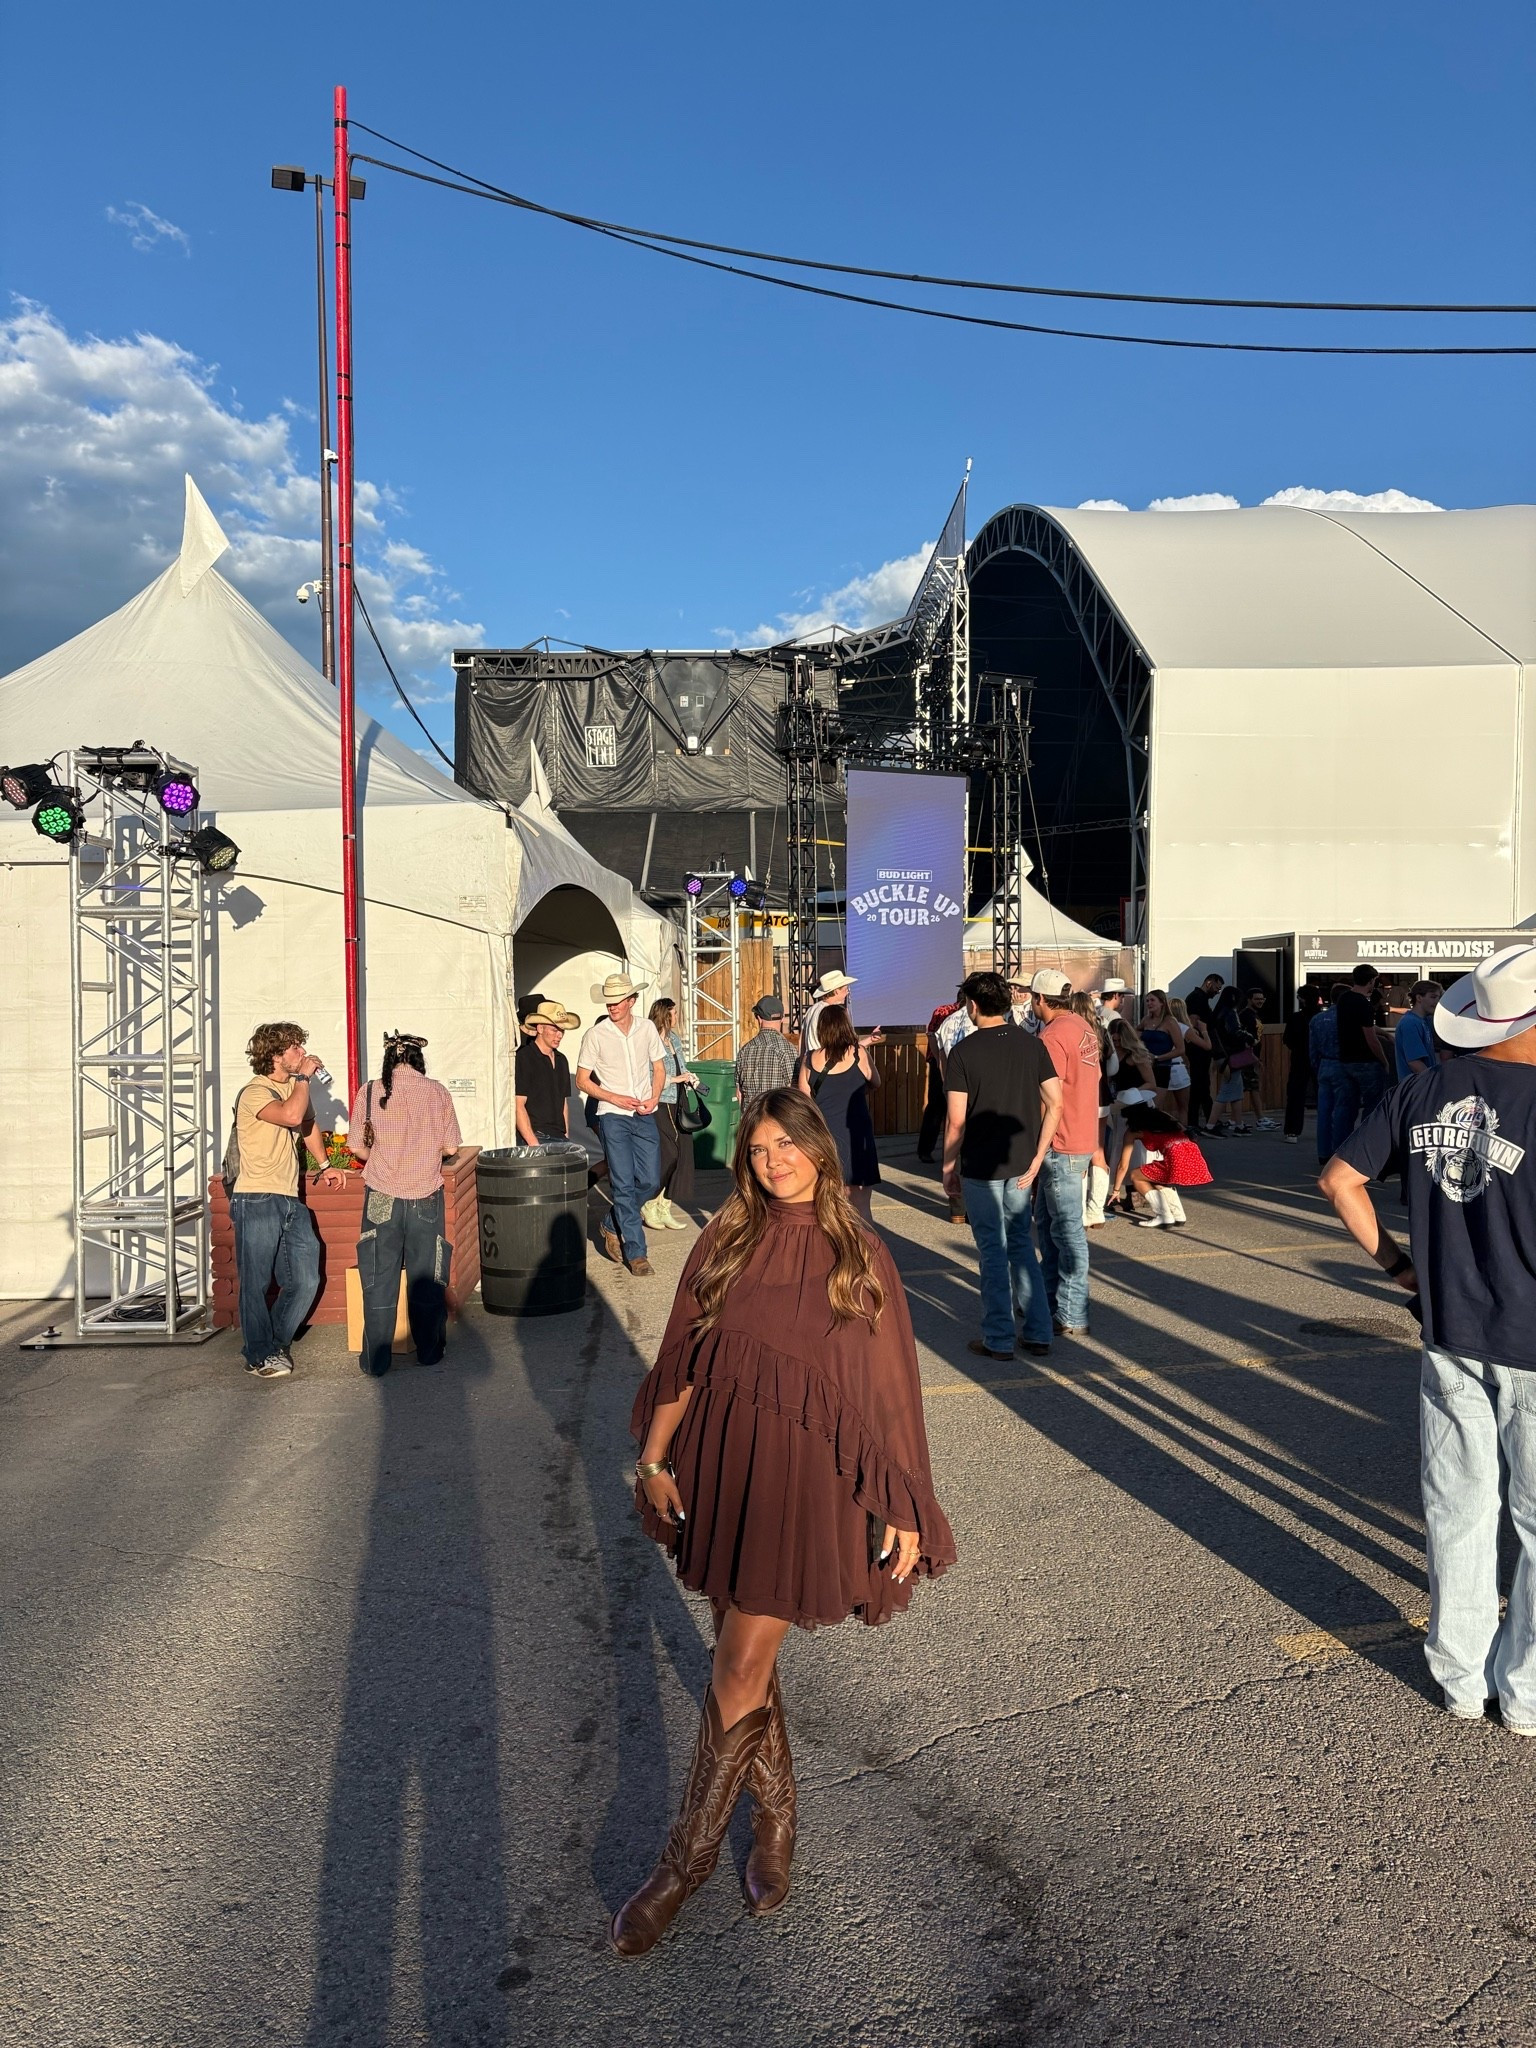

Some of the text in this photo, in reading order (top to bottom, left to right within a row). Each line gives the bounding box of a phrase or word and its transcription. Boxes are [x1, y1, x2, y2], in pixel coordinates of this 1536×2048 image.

[588, 728, 613, 745] STAGE
[589, 746, 614, 765] LINE
[879, 871, 930, 880] BUD LIGHT
[850, 884, 960, 918] BUCKLE UP
[866, 908, 940, 925] 20 TOUR 26
[1356, 940, 1495, 958] MERCHANDISE
